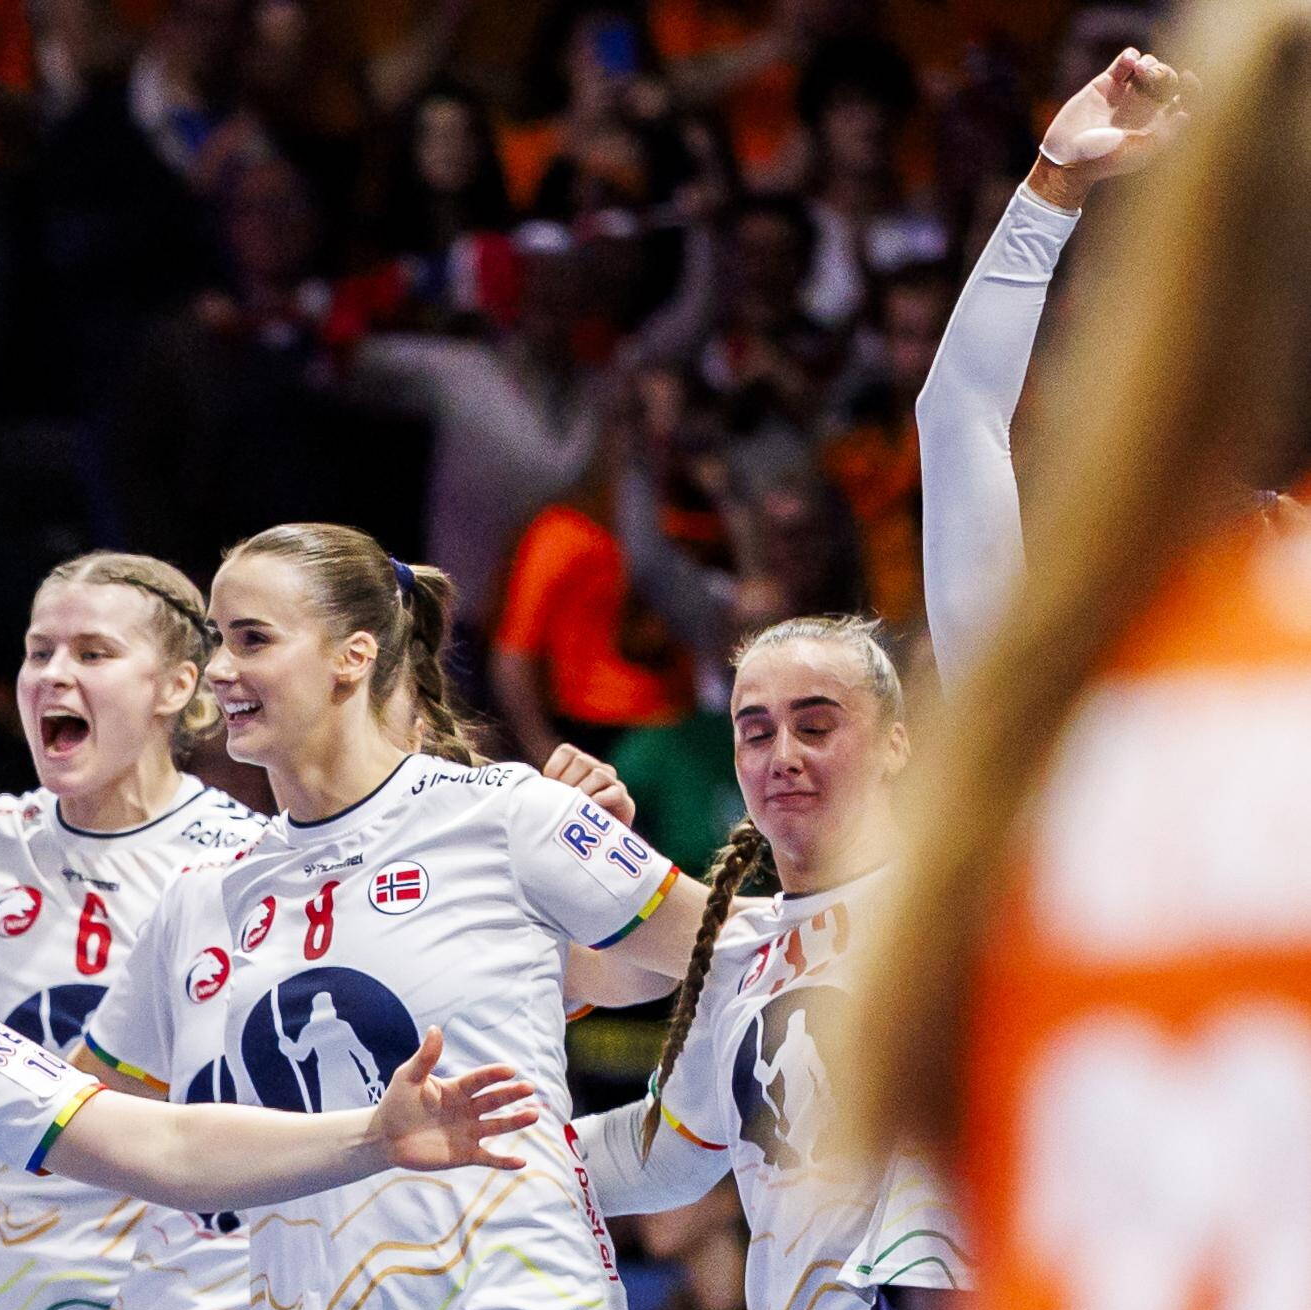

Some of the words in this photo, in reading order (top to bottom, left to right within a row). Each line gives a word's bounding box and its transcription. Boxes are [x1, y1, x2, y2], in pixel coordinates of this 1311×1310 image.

[609, 836, 649, 875] 10
[76, 892, 112, 976] 6
[304, 880, 341, 961] 8
